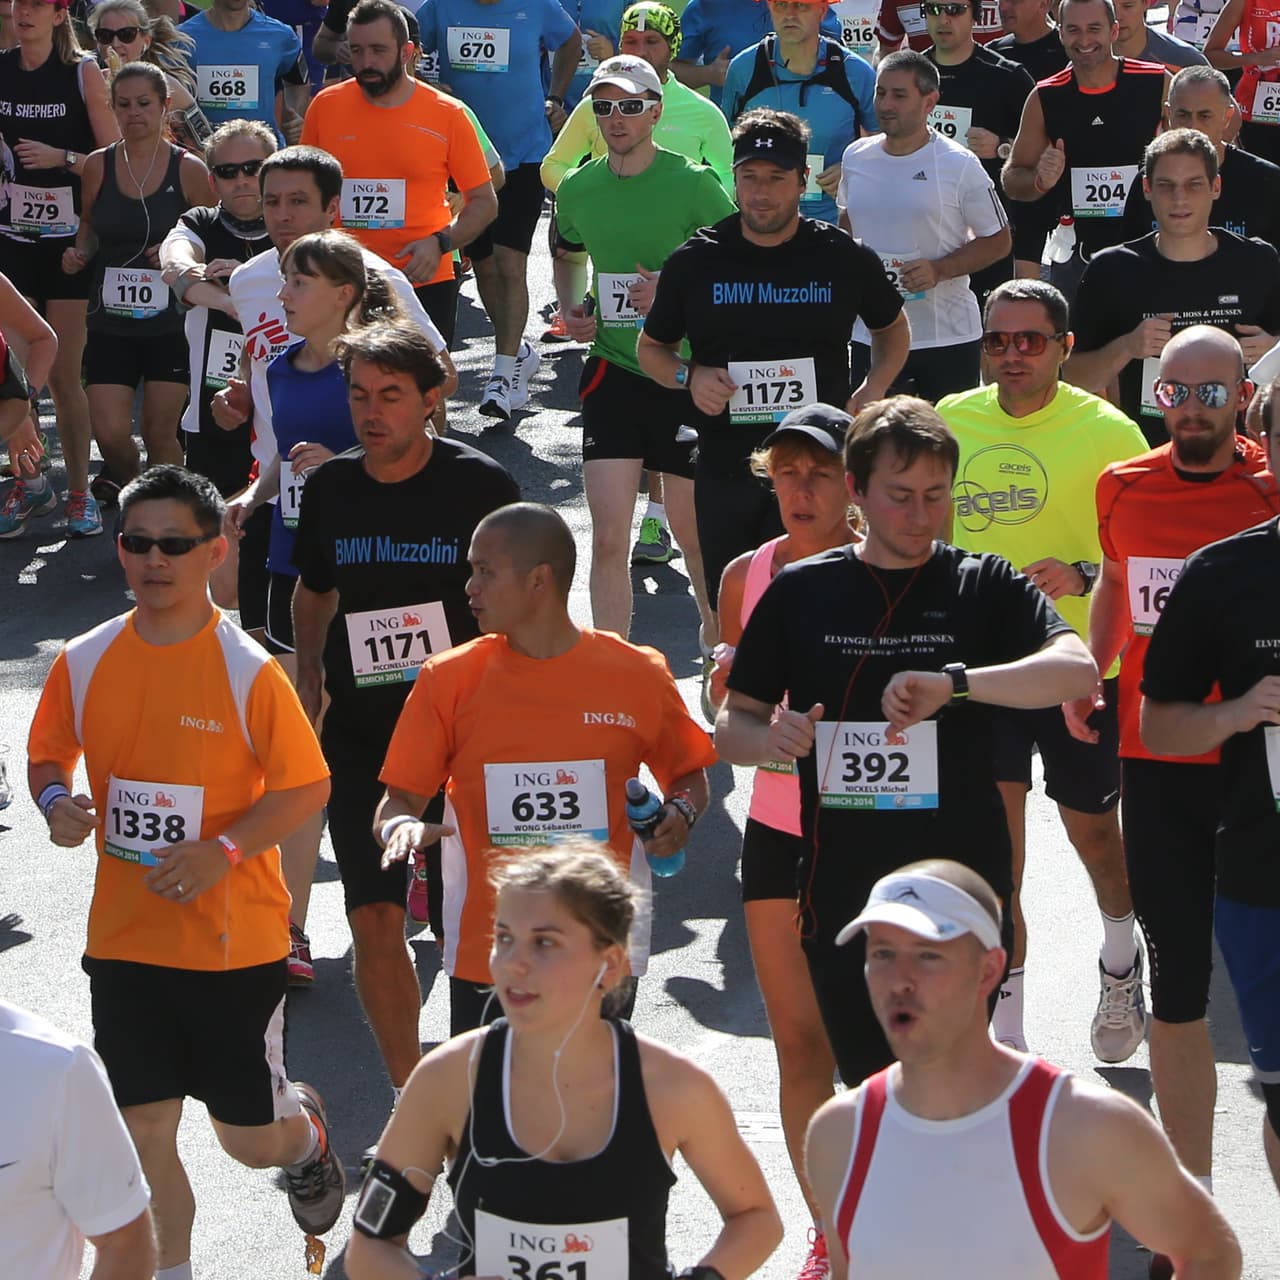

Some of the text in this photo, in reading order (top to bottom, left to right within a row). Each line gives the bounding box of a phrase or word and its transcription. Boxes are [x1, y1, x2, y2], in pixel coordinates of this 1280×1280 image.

[843, 18, 859, 26] ING
[462, 31, 482, 40] ING
[843, 27, 873, 42] 816
[459, 42, 496, 58] 670
[211, 69, 231, 78] ING
[209, 80, 246, 96] 668
[16, 103, 66, 118] SHEPHERD
[1086, 173, 1108, 182] ING
[24, 191, 43, 200] ING
[353, 184, 374, 193] ING
[1085, 183, 1127, 202] 204
[22, 202, 59, 220] 279
[352, 196, 389, 214] 172
[117, 273, 138, 282] ING
[117, 285, 152, 304] 110
[713, 281, 832, 305] BMW Muzzolini
[1211, 309, 1242, 317] PRUSSEN
[749, 367, 776, 379] ING
[742, 380, 804, 405] 1173
[732, 413, 772, 422] REMICH 2014
[952, 484, 1040, 517] aceis
[335, 535, 458, 565] BMW Muzzolini
[1150, 567, 1180, 581] ING
[370, 617, 399, 632] ING
[364, 629, 433, 663] 1171
[911, 634, 954, 644] PRUSSEN
[372, 661, 409, 672] PICCINELLI
[357, 673, 403, 685] REMICH 2014
[180, 715, 206, 731] ING
[583, 712, 616, 725] ING
[844, 732, 881, 747] ING
[841, 752, 910, 783] 392
[514, 772, 551, 787] ING
[845, 784, 908, 793] NICKELS Michel
[118, 790, 149, 807] ING
[511, 790, 581, 822] 633
[821, 795, 873, 806] REMICH 2014
[111, 807, 186, 843] 1338
[514, 823, 539, 832] WONG
[492, 835, 524, 844] REMICH
[508, 1232, 557, 1252] ING
